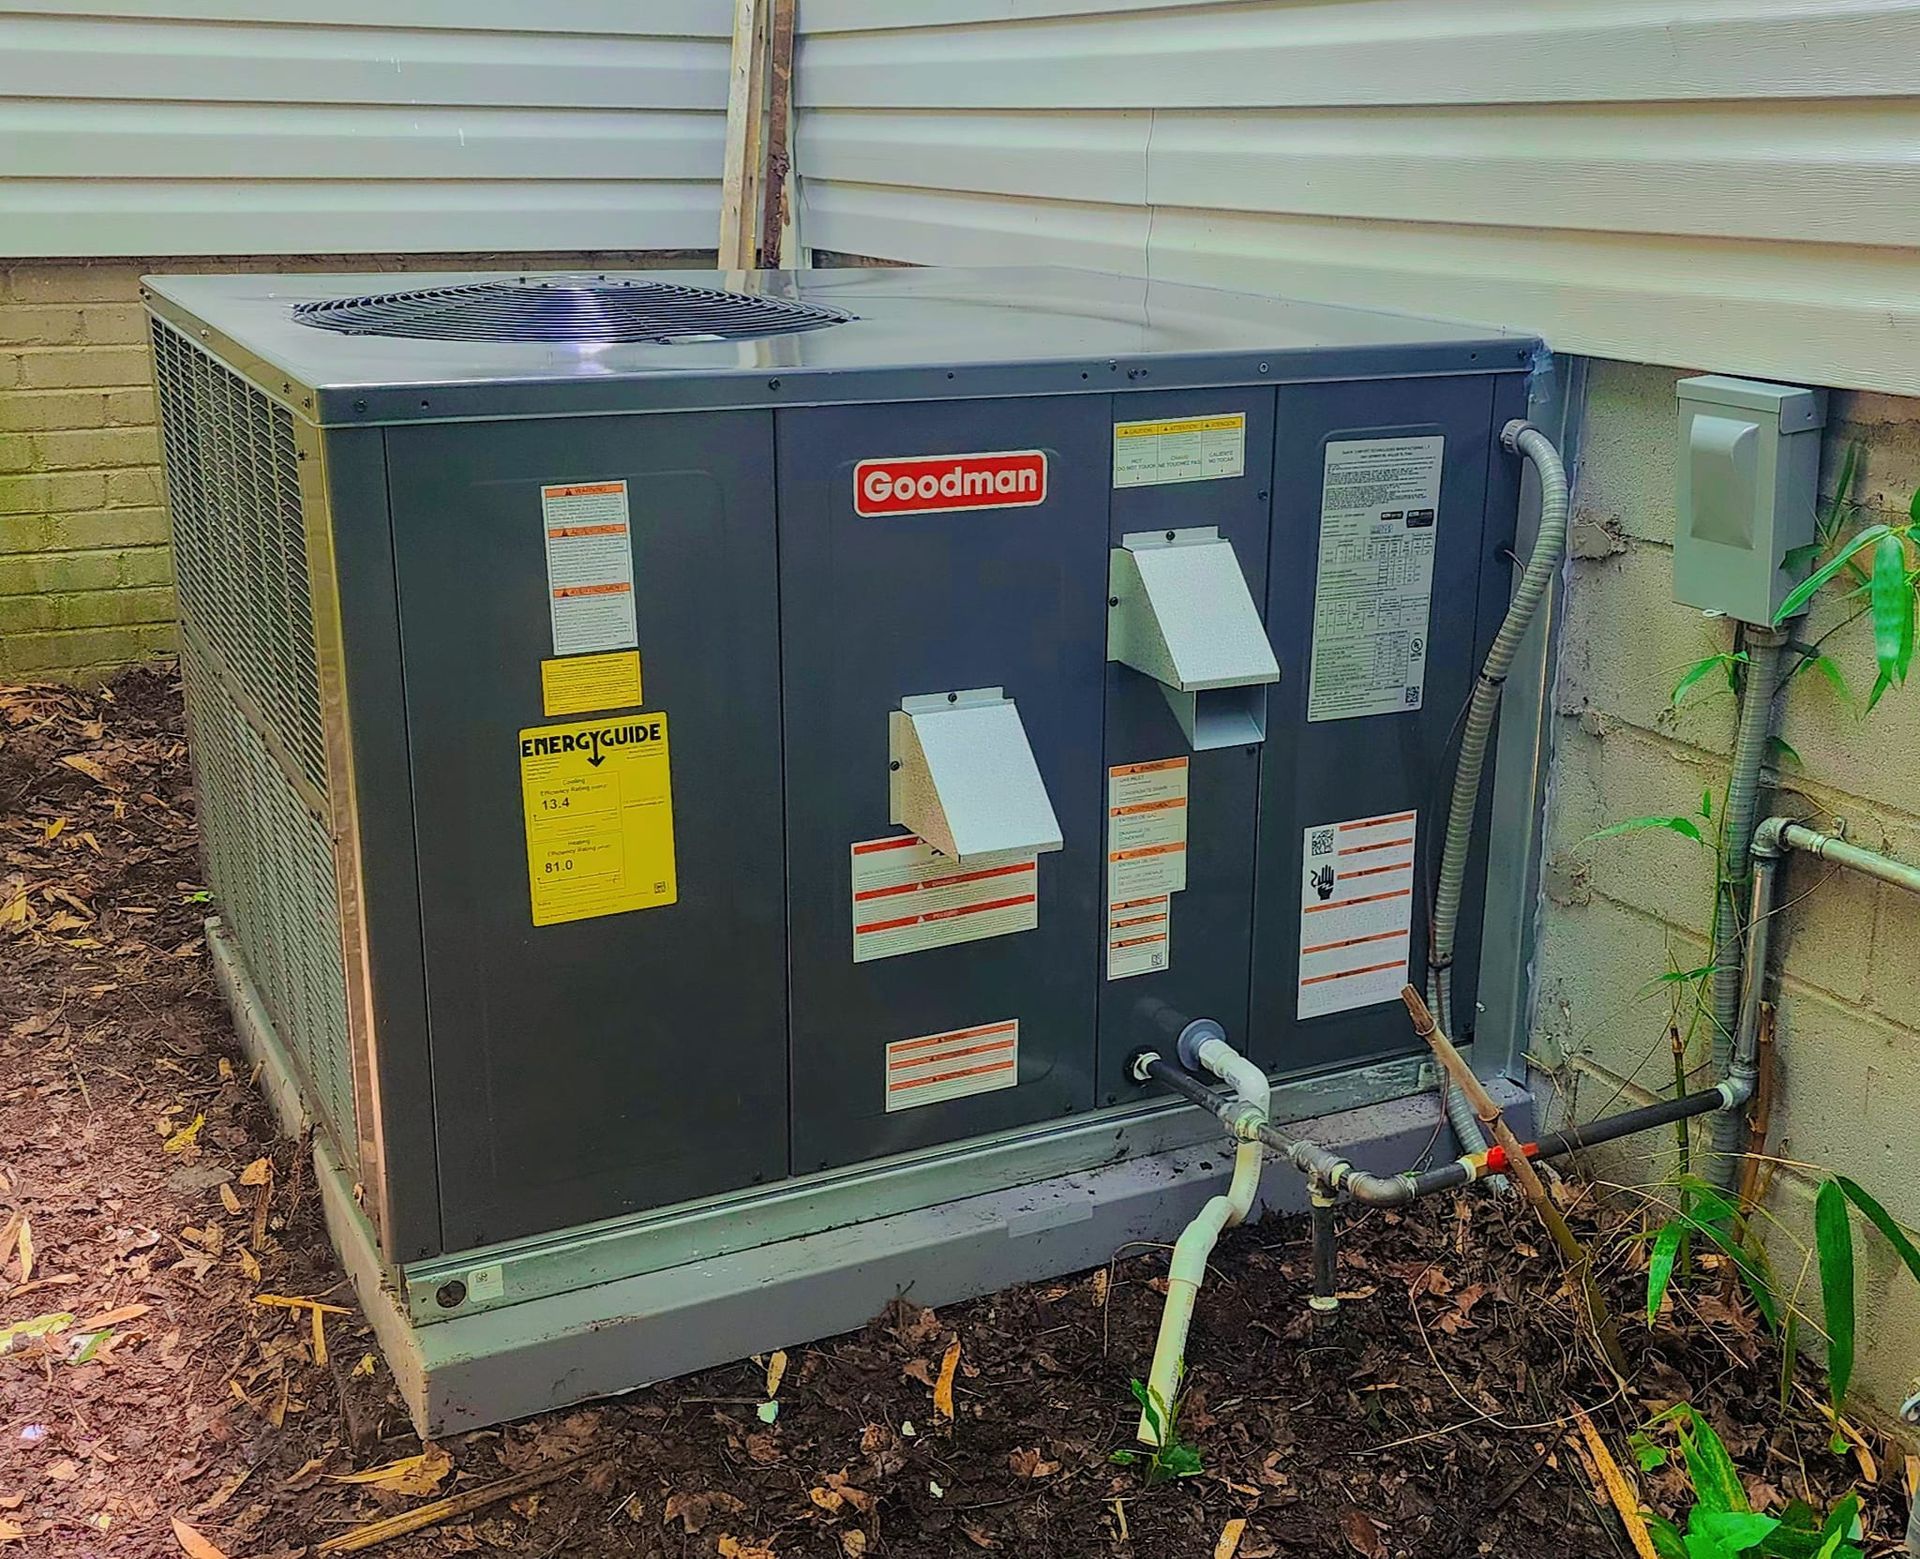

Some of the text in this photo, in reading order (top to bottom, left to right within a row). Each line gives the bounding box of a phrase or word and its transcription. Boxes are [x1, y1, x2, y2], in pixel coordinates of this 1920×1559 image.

[863, 466, 1037, 502] Goodman
[542, 797, 570, 811] 13.4
[545, 859, 573, 874] 81.0
